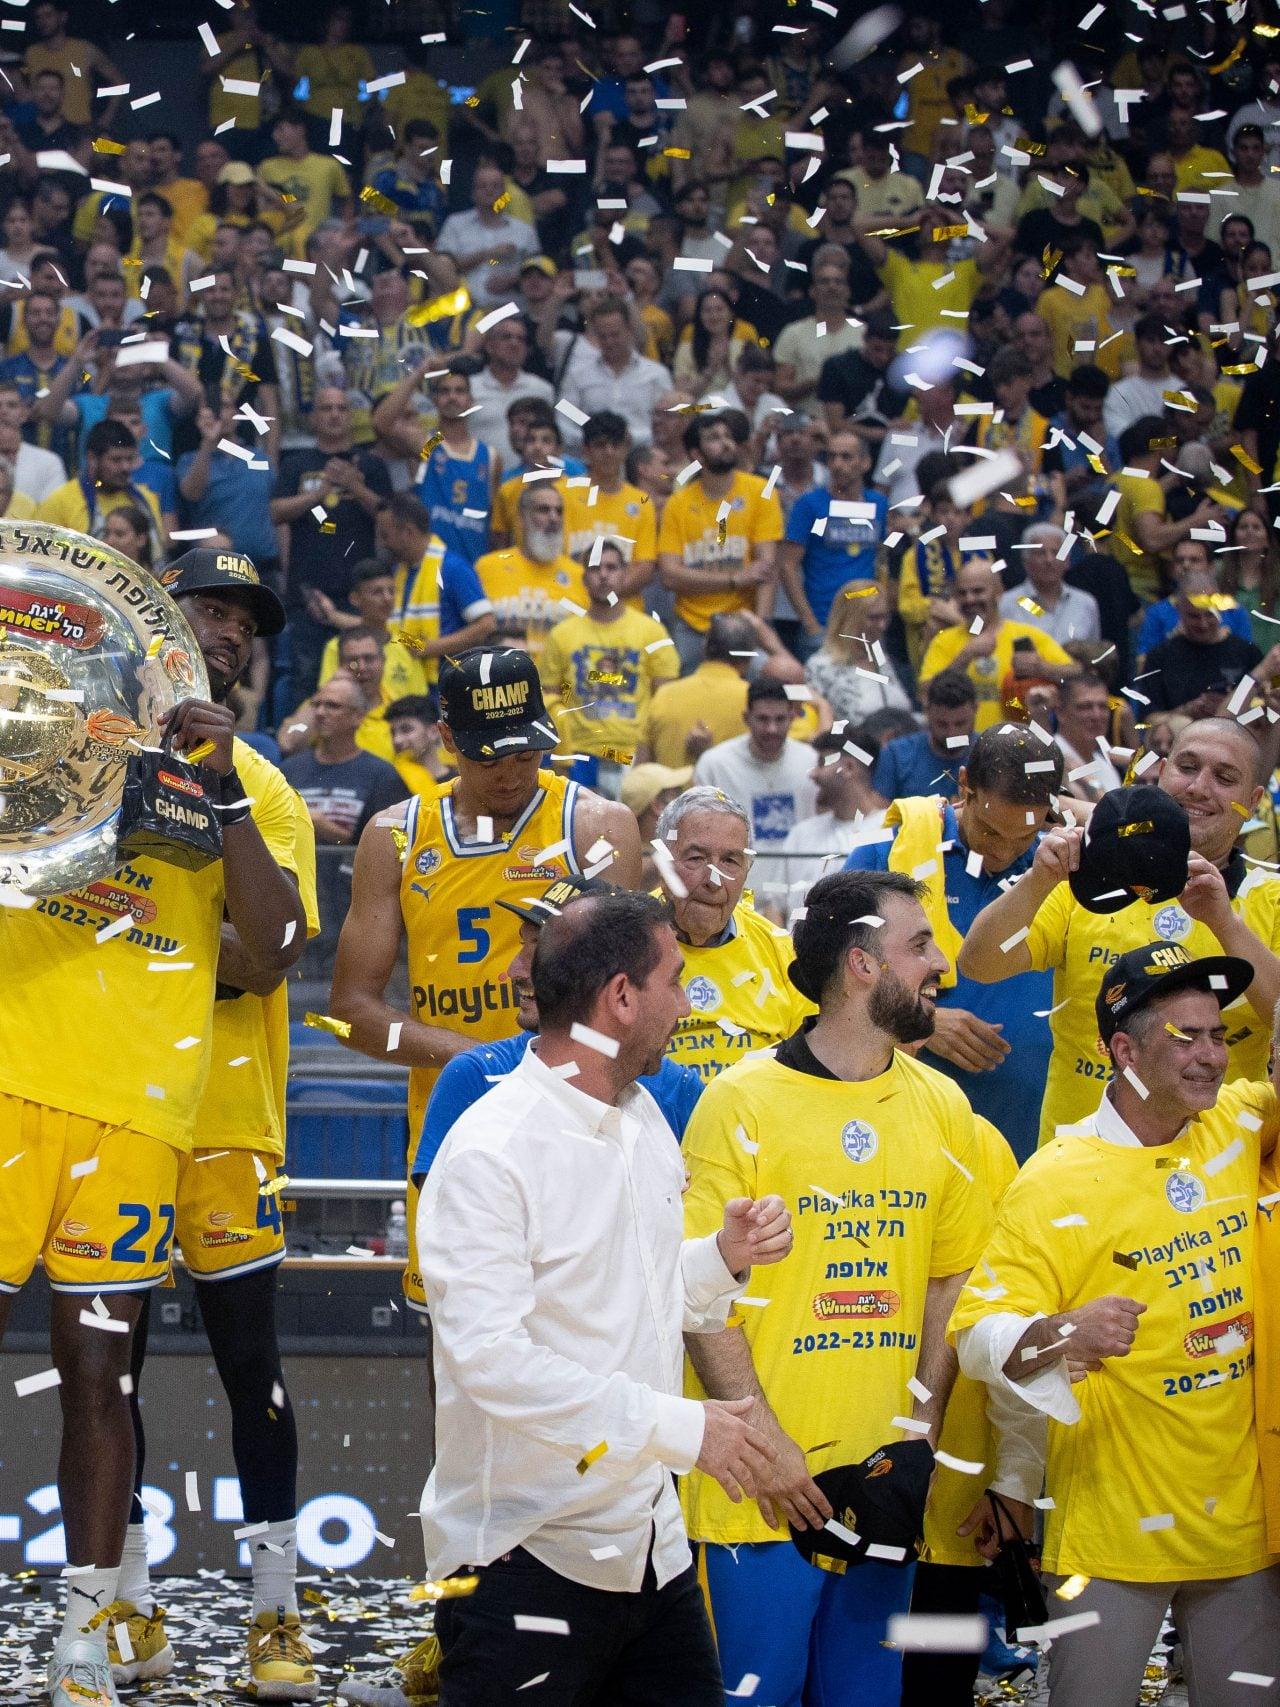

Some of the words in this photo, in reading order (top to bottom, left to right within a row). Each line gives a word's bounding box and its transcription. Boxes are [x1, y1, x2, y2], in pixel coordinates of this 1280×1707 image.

[13, 529, 106, 572] ישראל
[28, 602, 66, 622] ליגת
[61, 618, 85, 640] סל
[471, 681, 529, 711] CHAMP
[155, 798, 209, 830] CHAMP
[507, 869, 544, 879] Winner
[35, 898, 120, 939] 2022-2
[126, 927, 178, 953] עונת
[456, 906, 491, 964] 5
[412, 973, 520, 1024] Playti
[880, 1189, 928, 1210] מכבי
[823, 1219, 870, 1241] אביב
[876, 1215, 905, 1238] תל
[56, 1241, 91, 1256] Winner
[825, 1257, 889, 1280] אלופת
[819, 1298, 877, 1316] Winner
[877, 1301, 889, 1314] סל
[1188, 1286, 1244, 1320] אלופת
[792, 1330, 874, 1355] 2022-23
